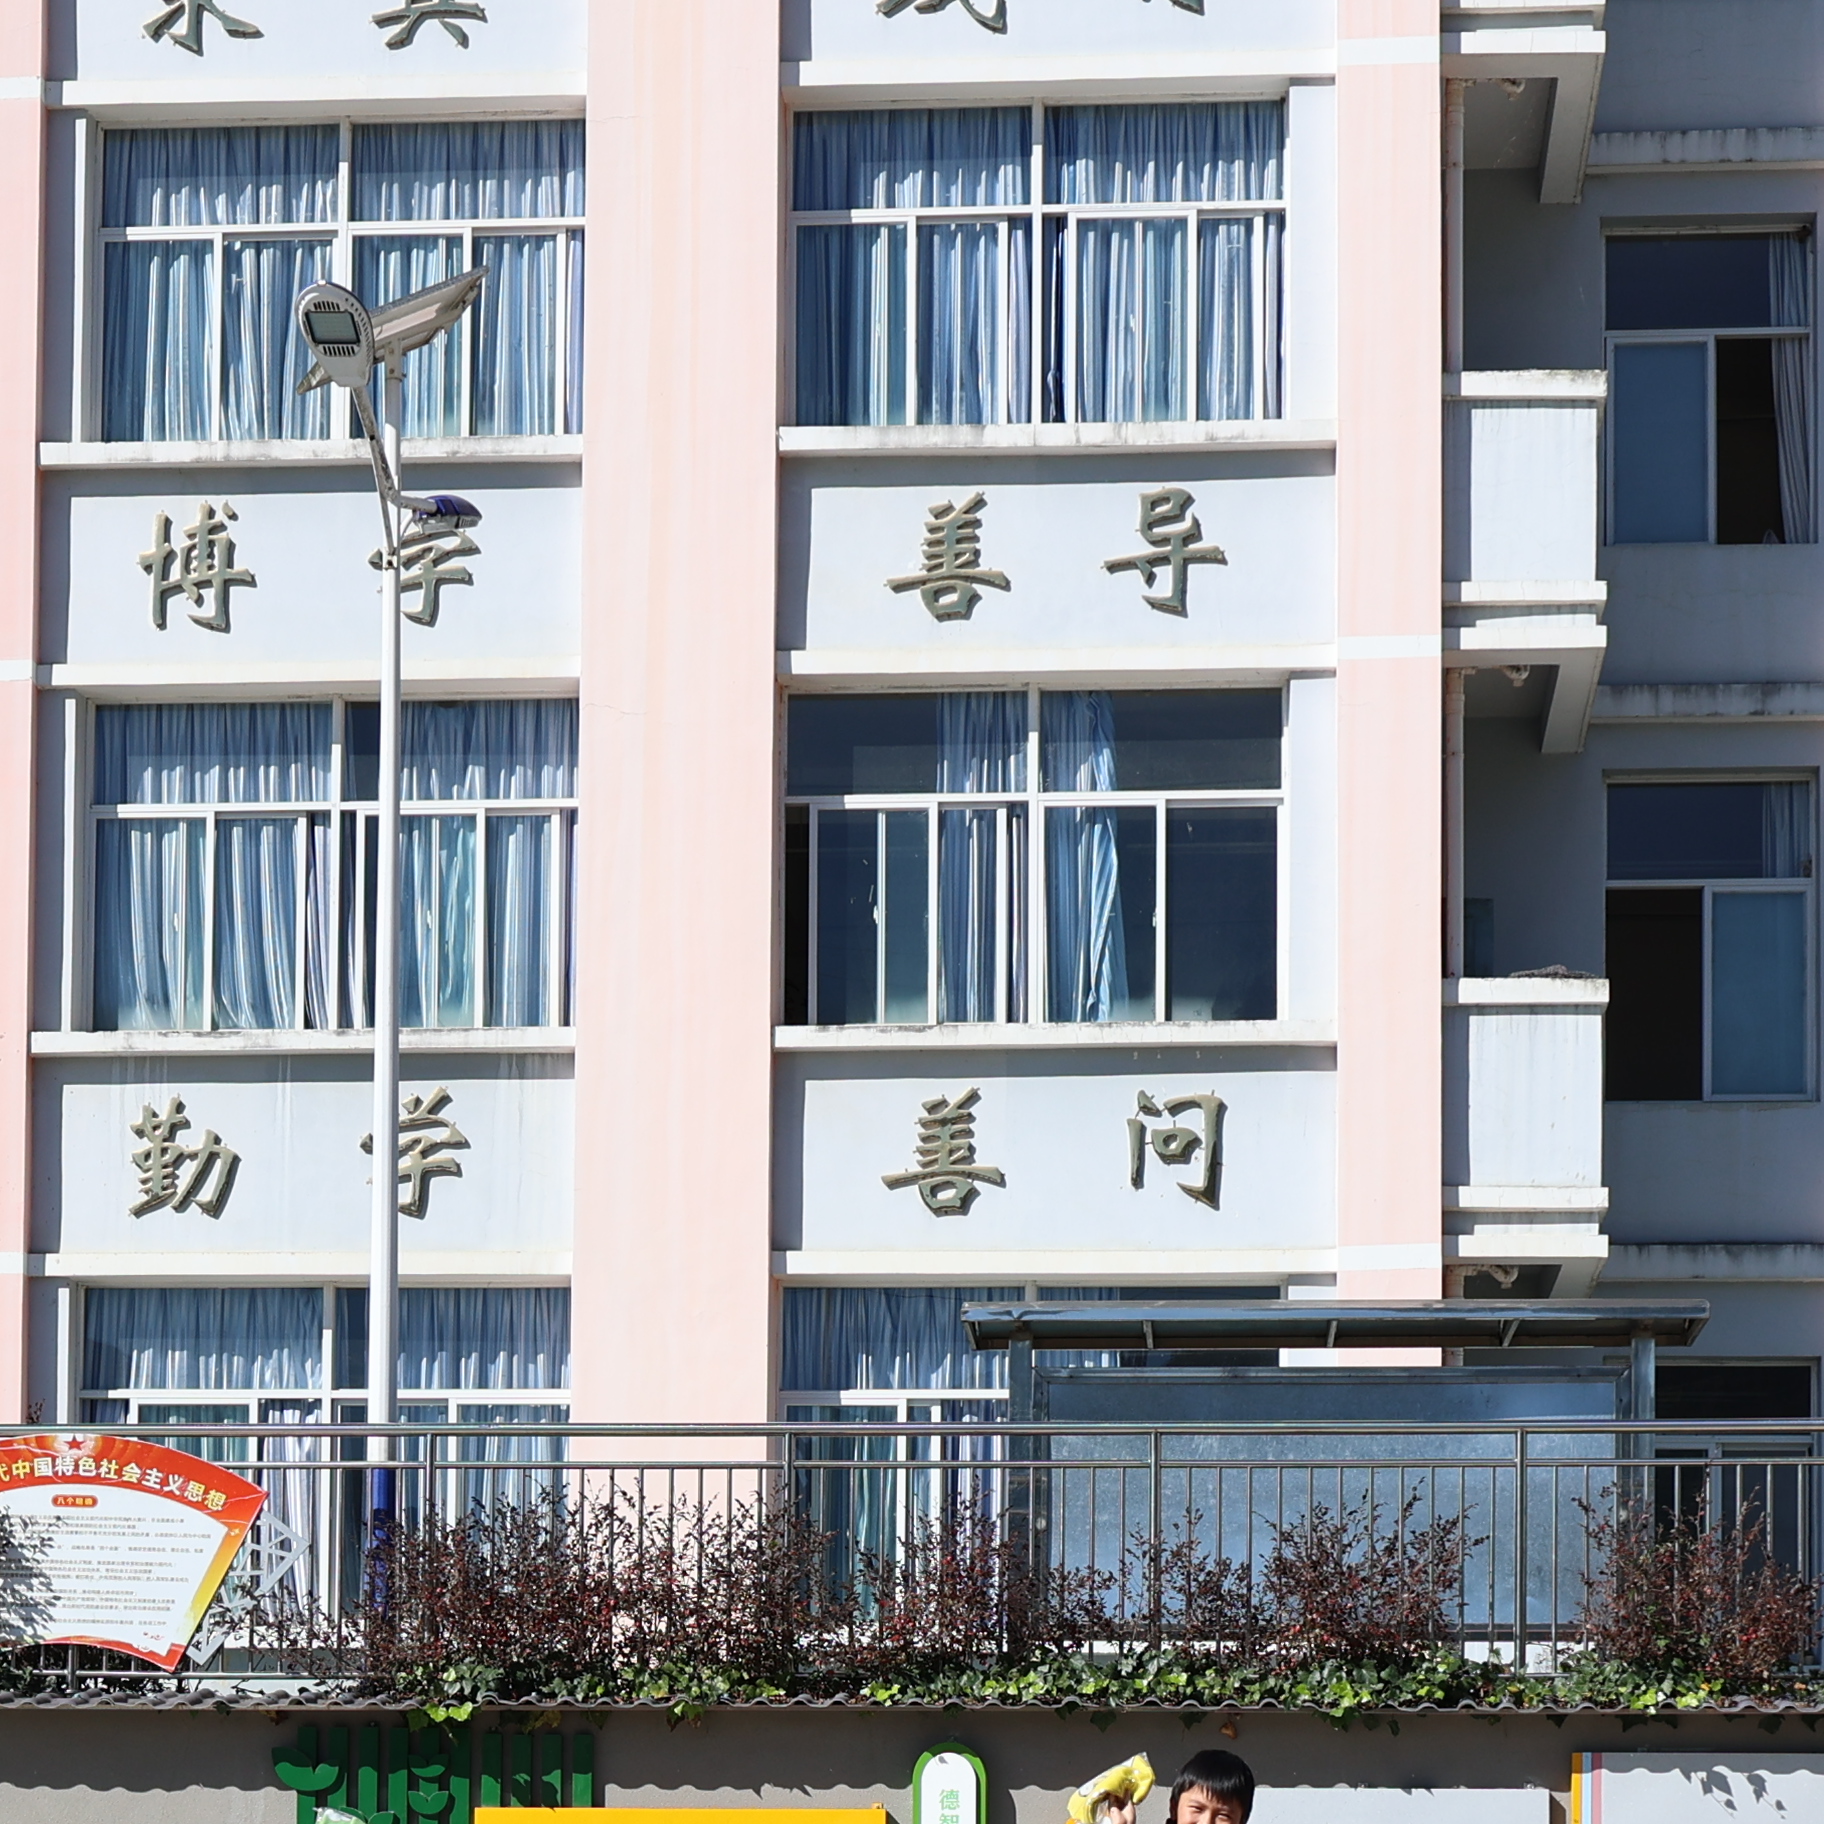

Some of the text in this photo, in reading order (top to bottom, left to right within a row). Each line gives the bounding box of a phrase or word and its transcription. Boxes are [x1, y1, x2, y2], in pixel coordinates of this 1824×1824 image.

[885, 487, 1227, 622] 善导
[129, 1092, 471, 1218] 勤学
[880, 1087, 1227, 1215] 善问
